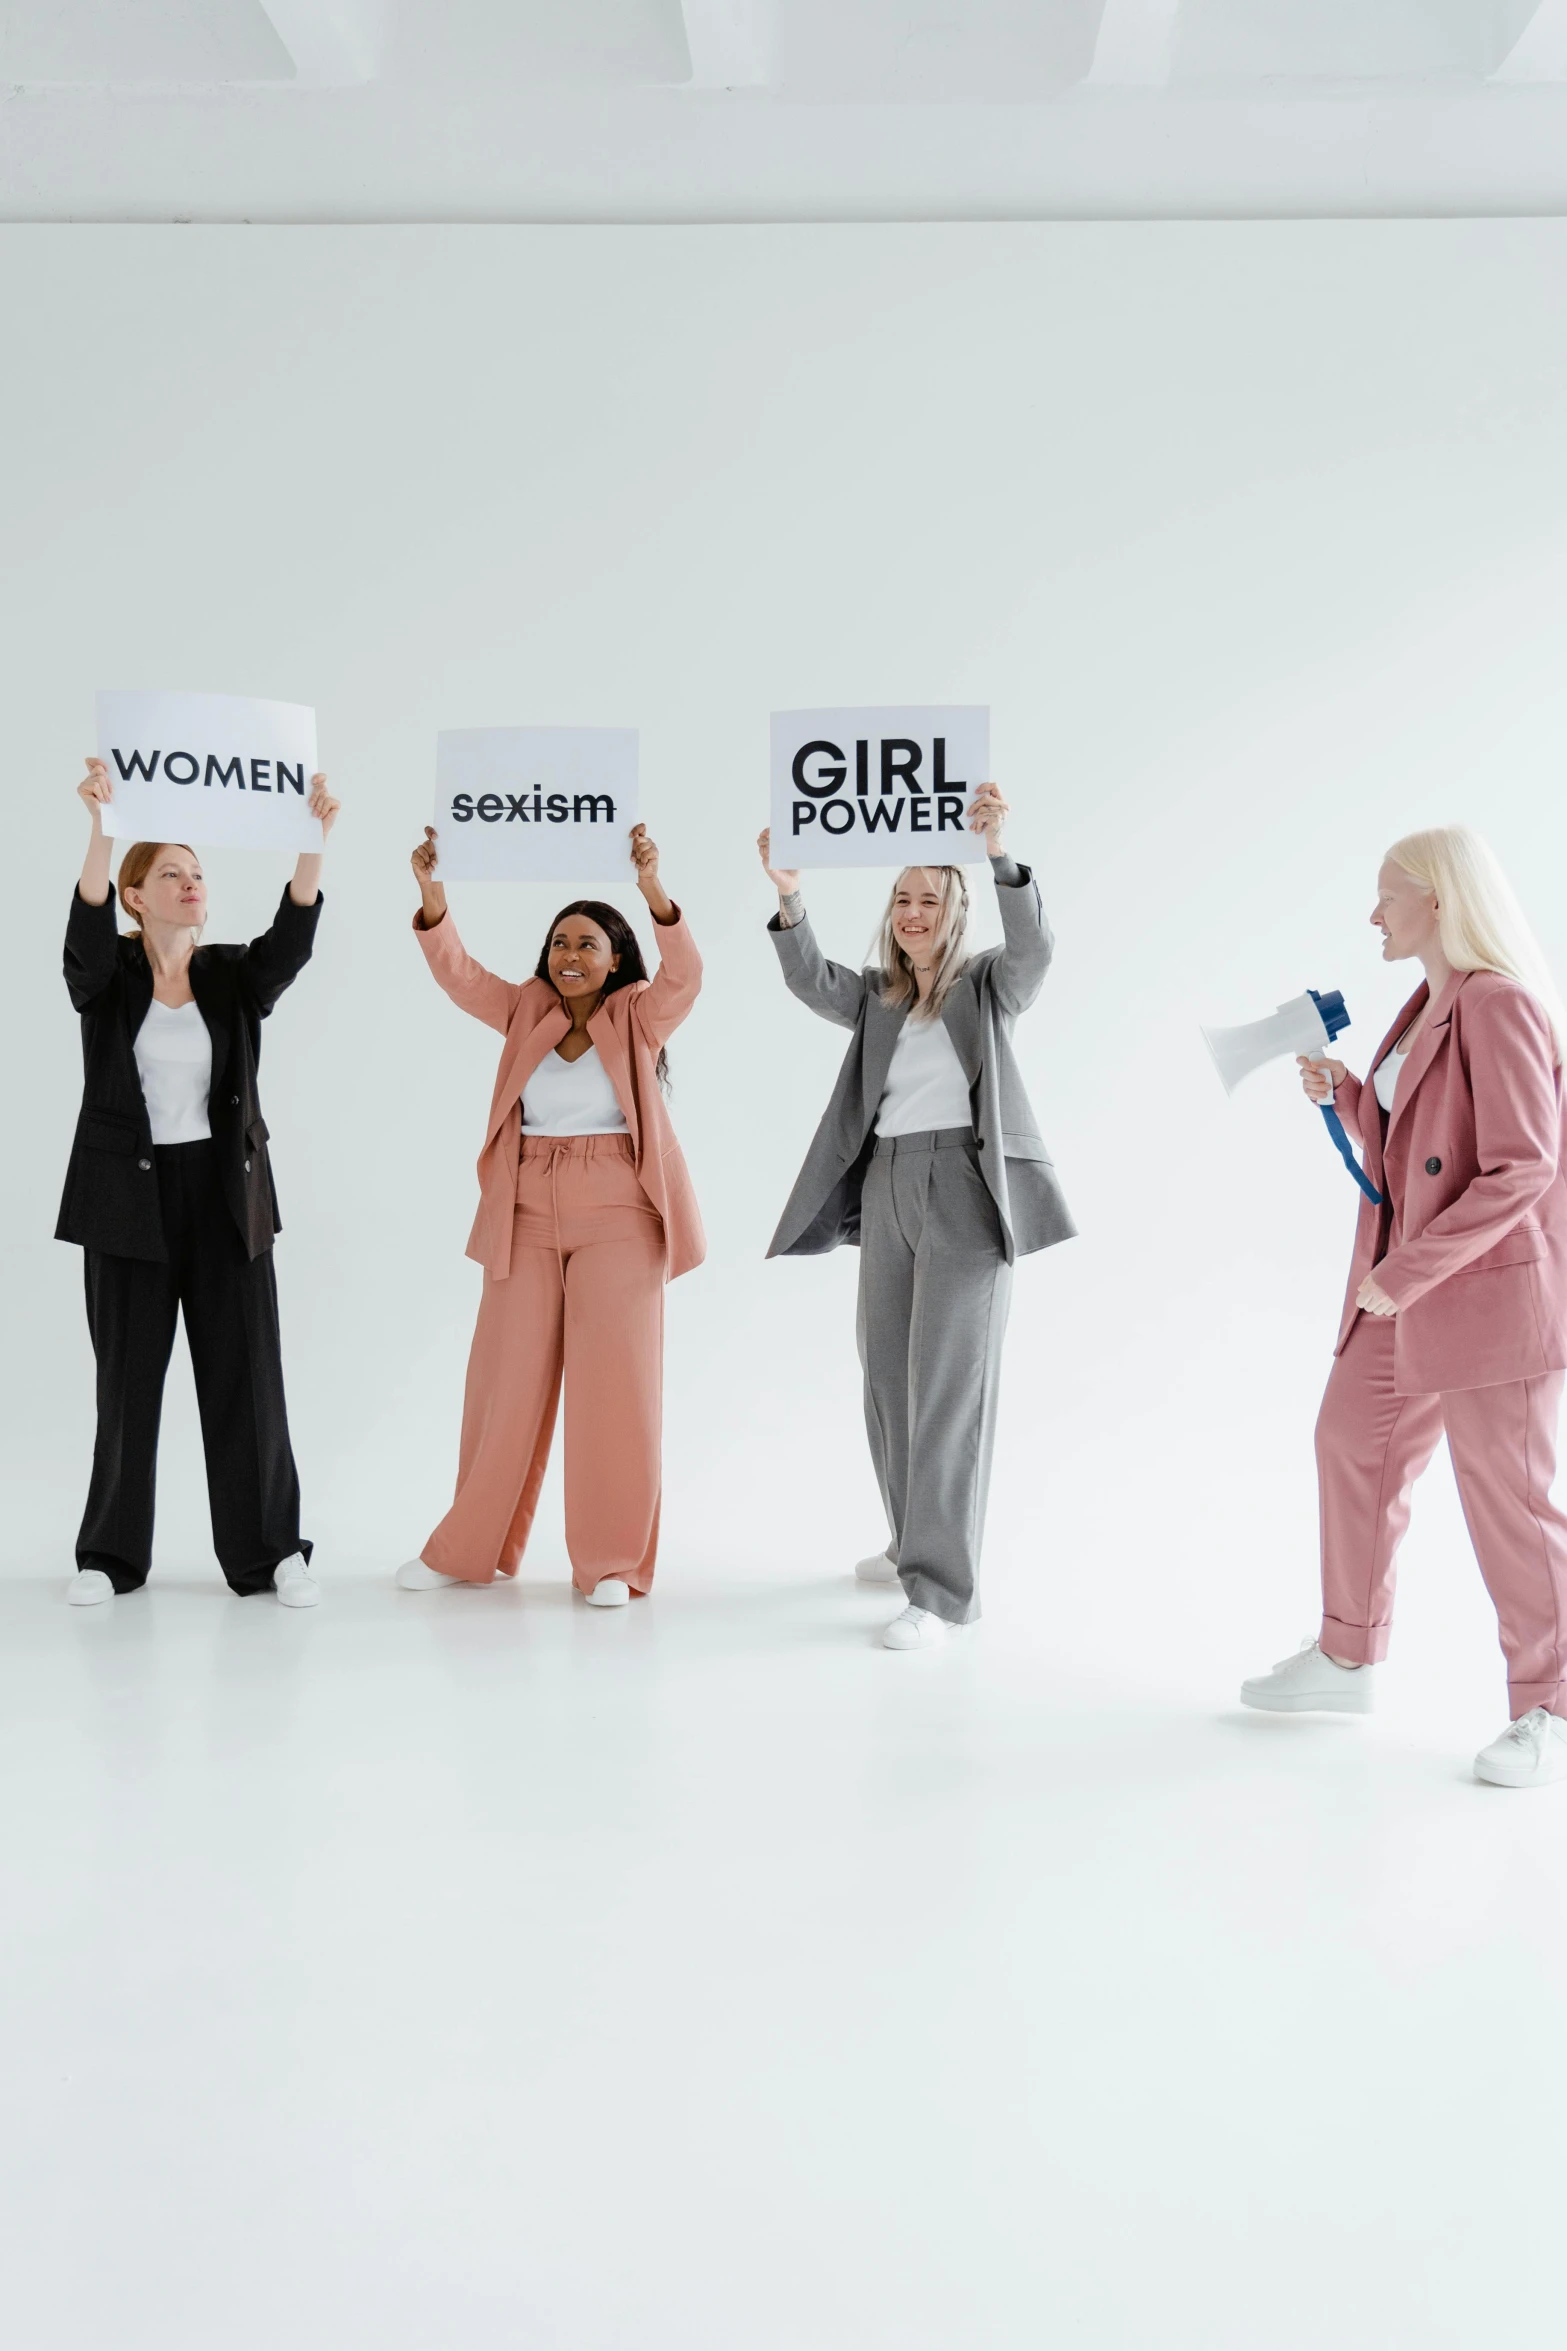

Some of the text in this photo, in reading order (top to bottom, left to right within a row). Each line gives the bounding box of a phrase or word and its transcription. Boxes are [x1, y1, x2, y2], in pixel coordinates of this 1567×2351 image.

[110, 748, 305, 796] WOMEN
[791, 737, 967, 799] GIRL
[450, 783, 618, 824] sexism
[792, 796, 965, 836] POWER
